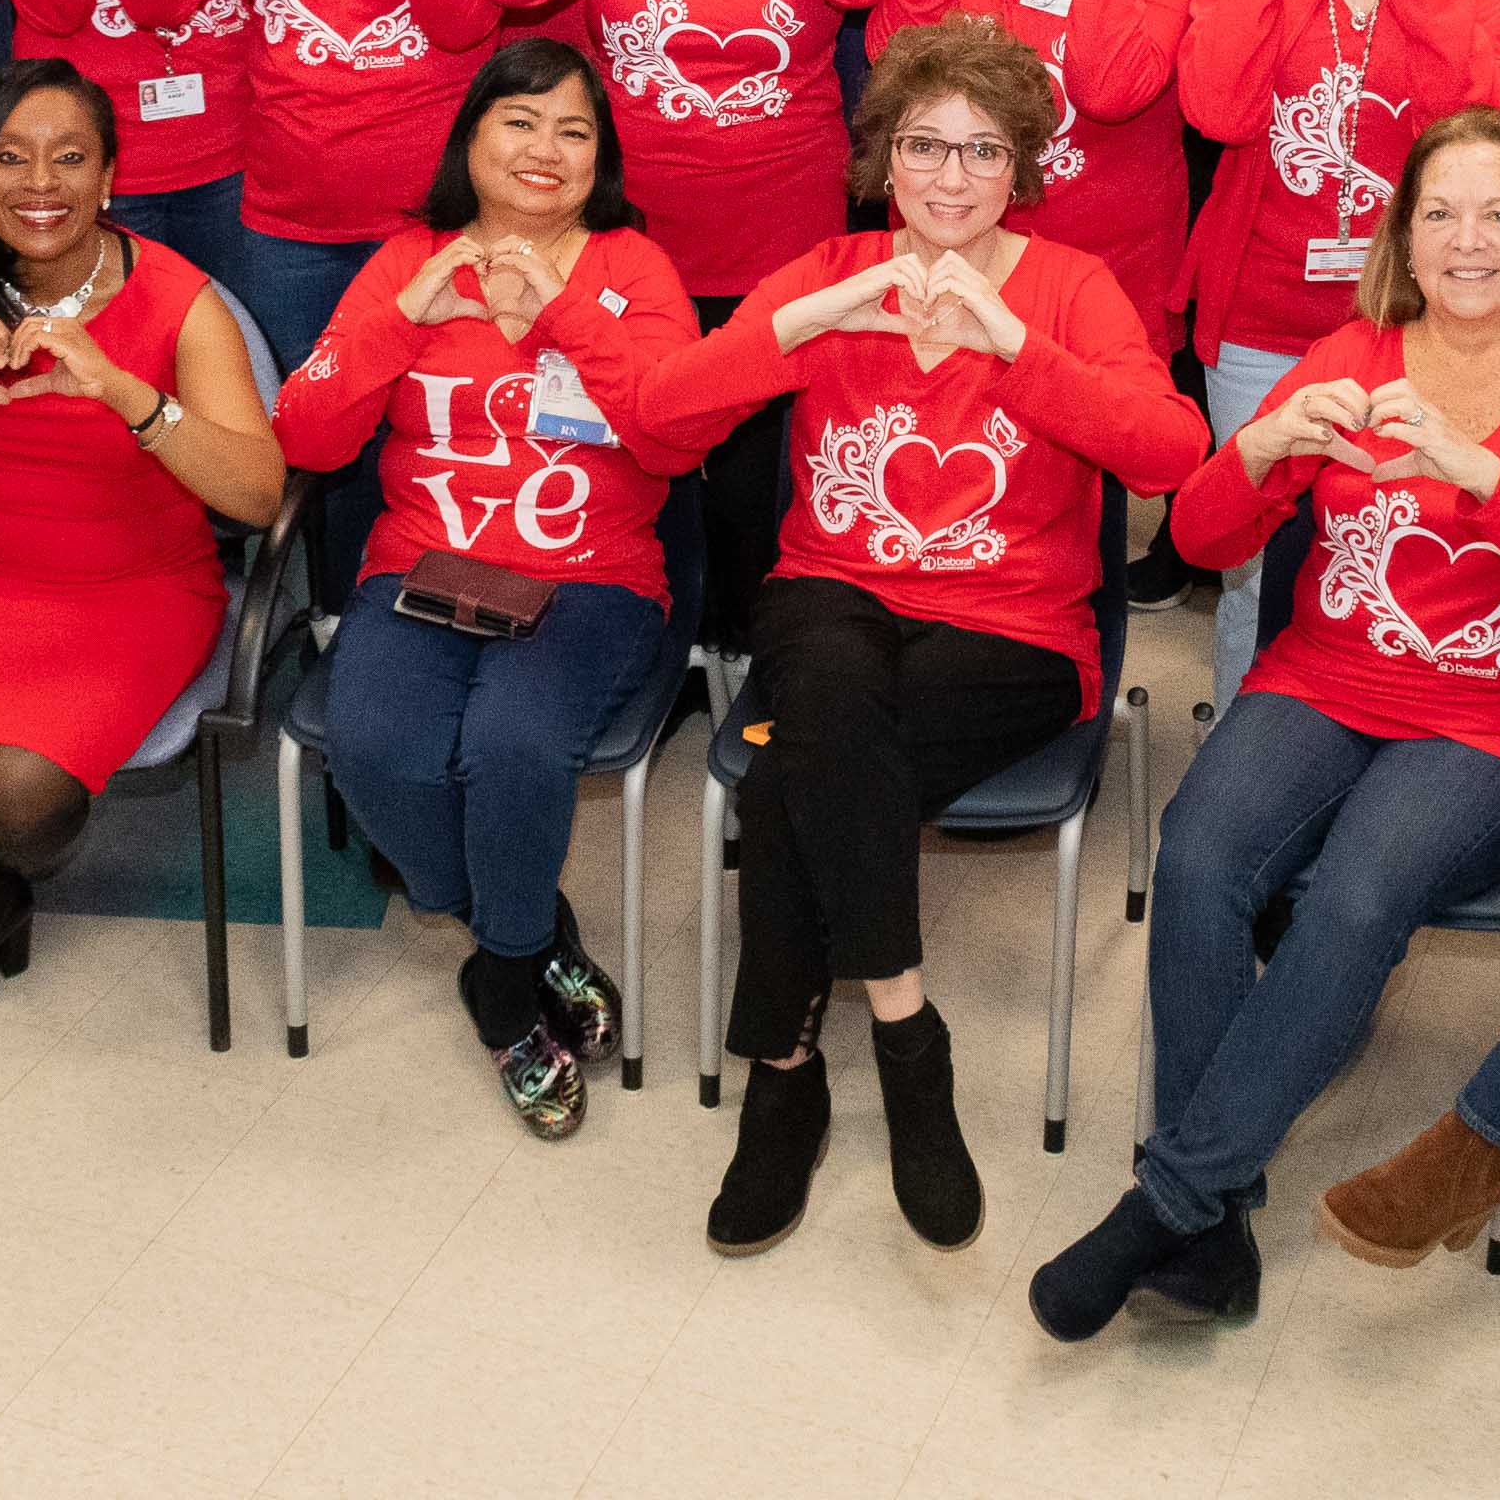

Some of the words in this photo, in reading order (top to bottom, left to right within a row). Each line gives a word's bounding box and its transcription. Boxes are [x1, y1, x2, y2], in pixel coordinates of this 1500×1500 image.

[369, 54, 404, 65] Deborah
[559, 424, 578, 437] RN
[937, 556, 975, 566] Deborah
[1455, 663, 1499, 678] Deborah
